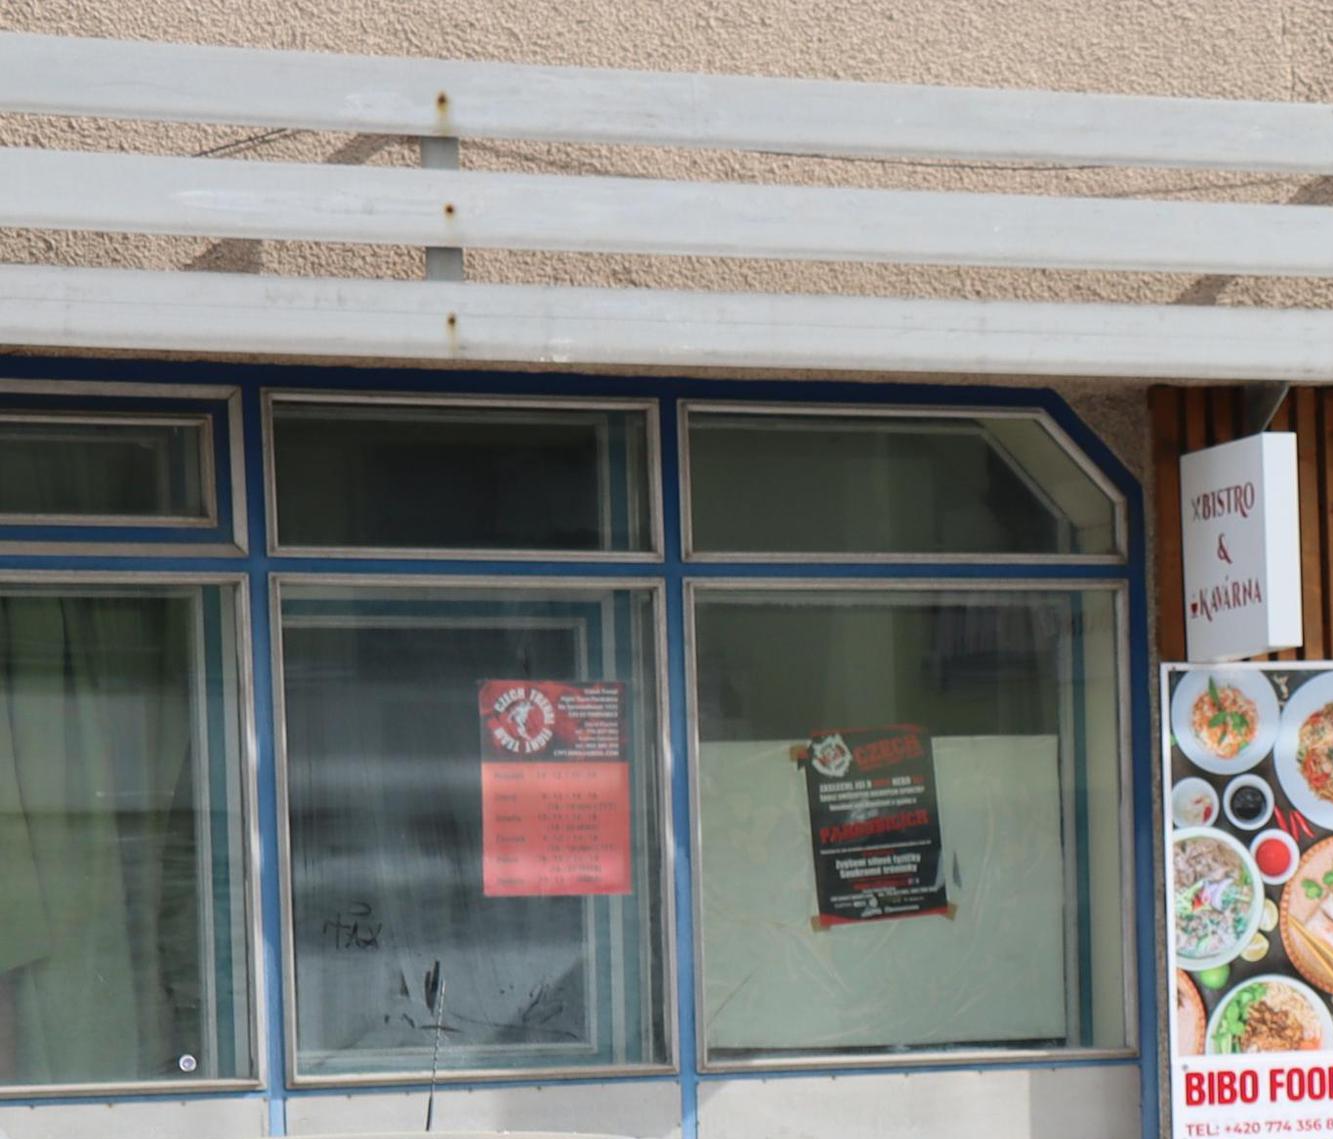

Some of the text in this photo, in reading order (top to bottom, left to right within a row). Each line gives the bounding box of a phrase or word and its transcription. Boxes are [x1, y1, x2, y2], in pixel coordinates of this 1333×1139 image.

[1202, 481, 1255, 520] BISTRO
[1217, 532, 1232, 564] &
[1200, 575, 1262, 621] KAVÁRNA
[1184, 1068, 1260, 1108] BIBO
[1186, 1123, 1219, 1137] TEL:
[1224, 1122, 1260, 1135] +420
[1264, 1120, 1292, 1132] 774
[1296, 1118, 1321, 1131] 356
